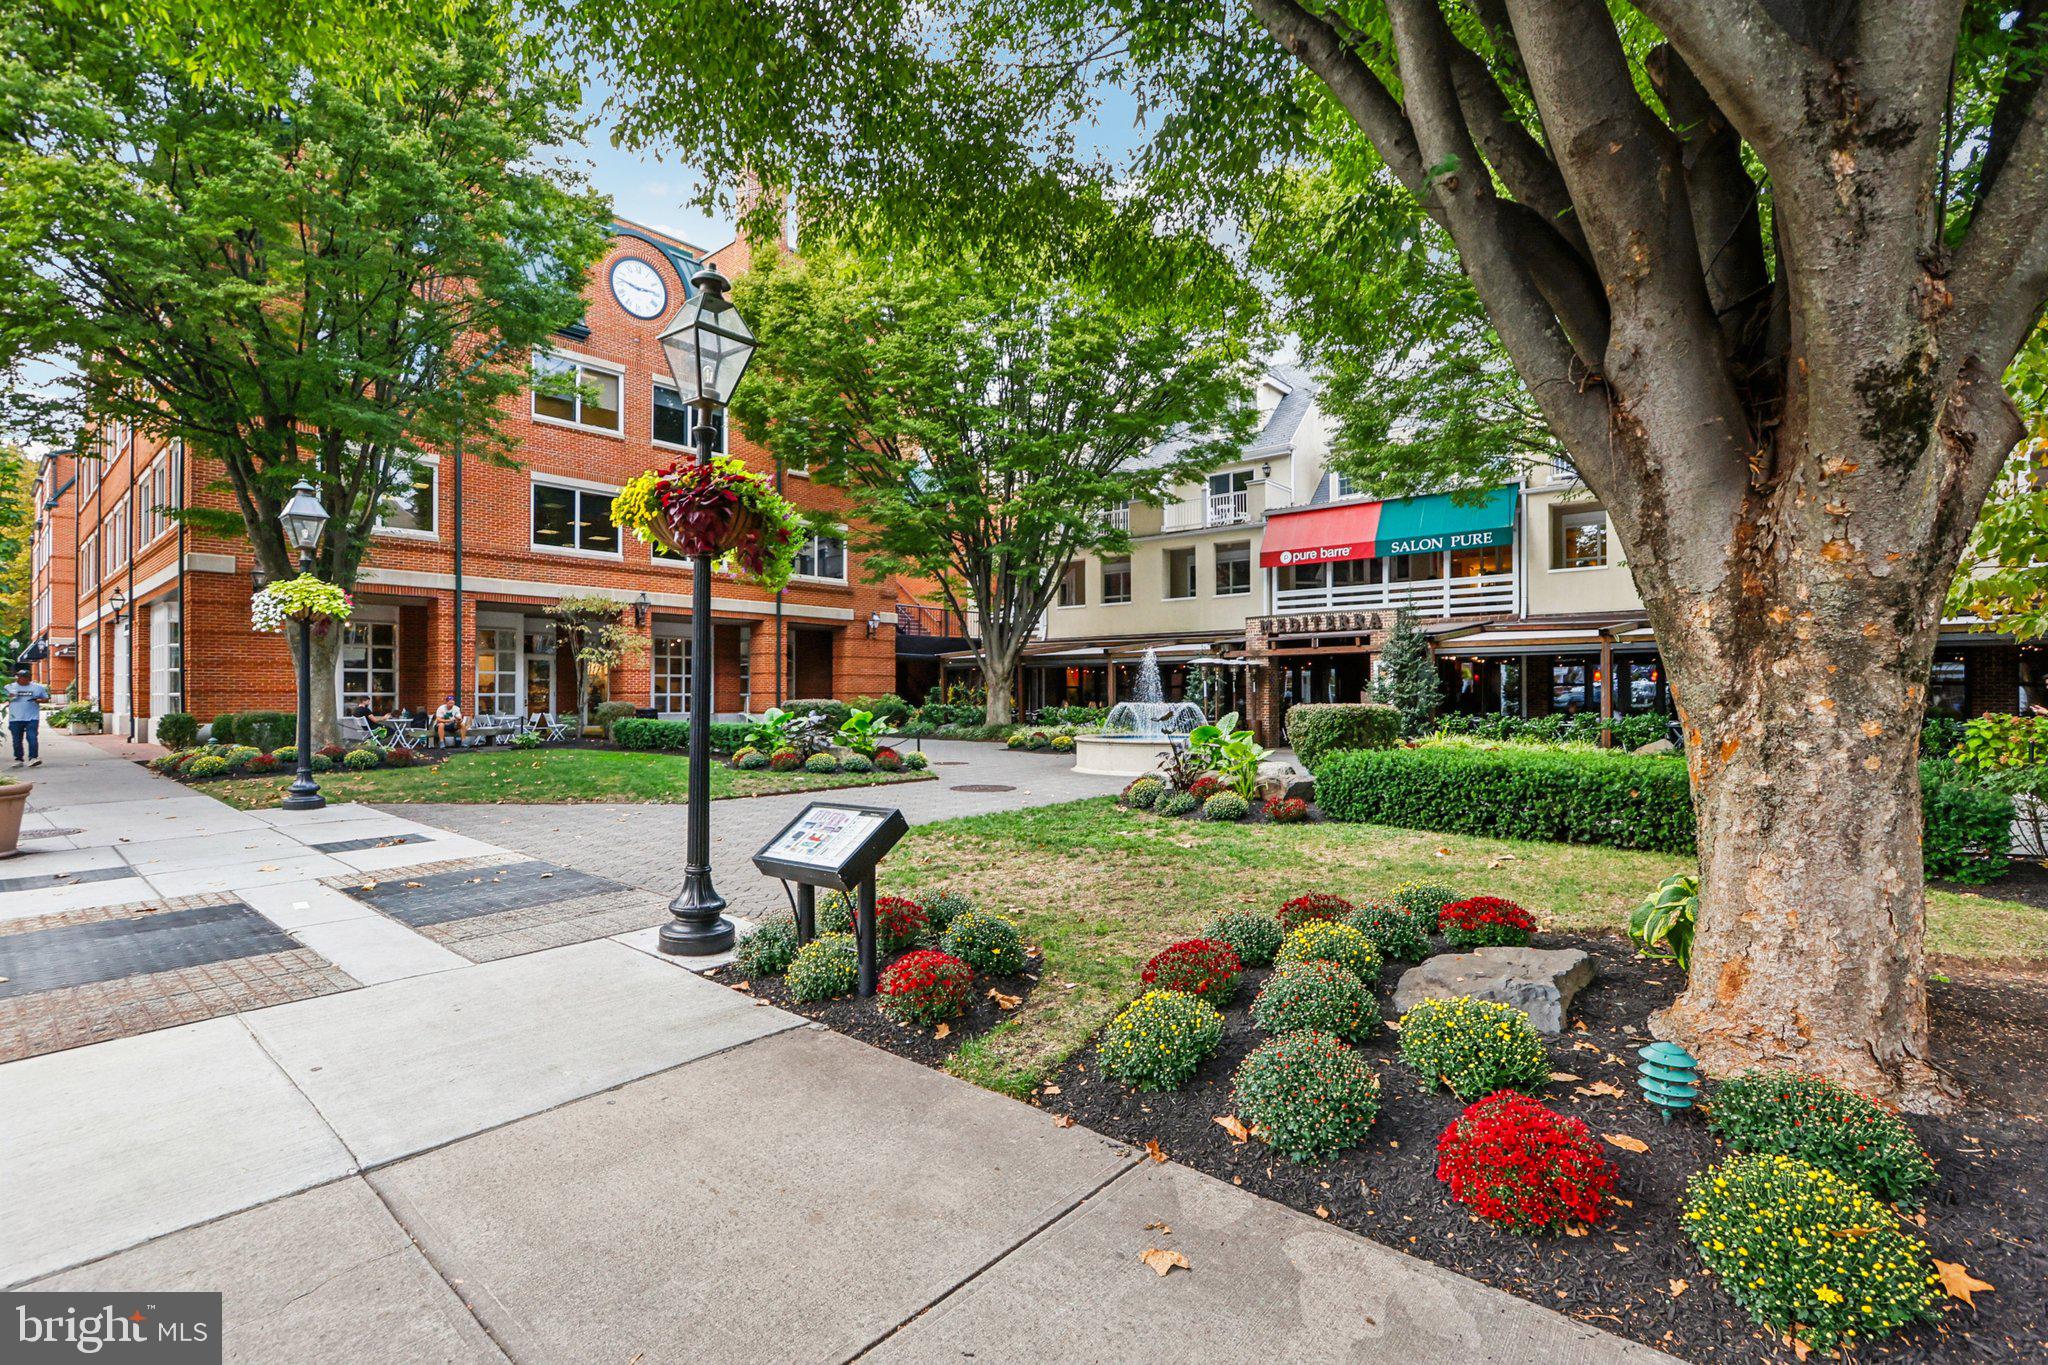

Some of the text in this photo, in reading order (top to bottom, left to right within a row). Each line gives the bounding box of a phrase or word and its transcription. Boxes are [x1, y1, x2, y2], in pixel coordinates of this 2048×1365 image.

[1391, 531, 1493, 554] SALON PURE
[1292, 550, 1317, 563] pure
[1320, 547, 1351, 559] barre
[1260, 612, 1383, 635] MEDITERRA
